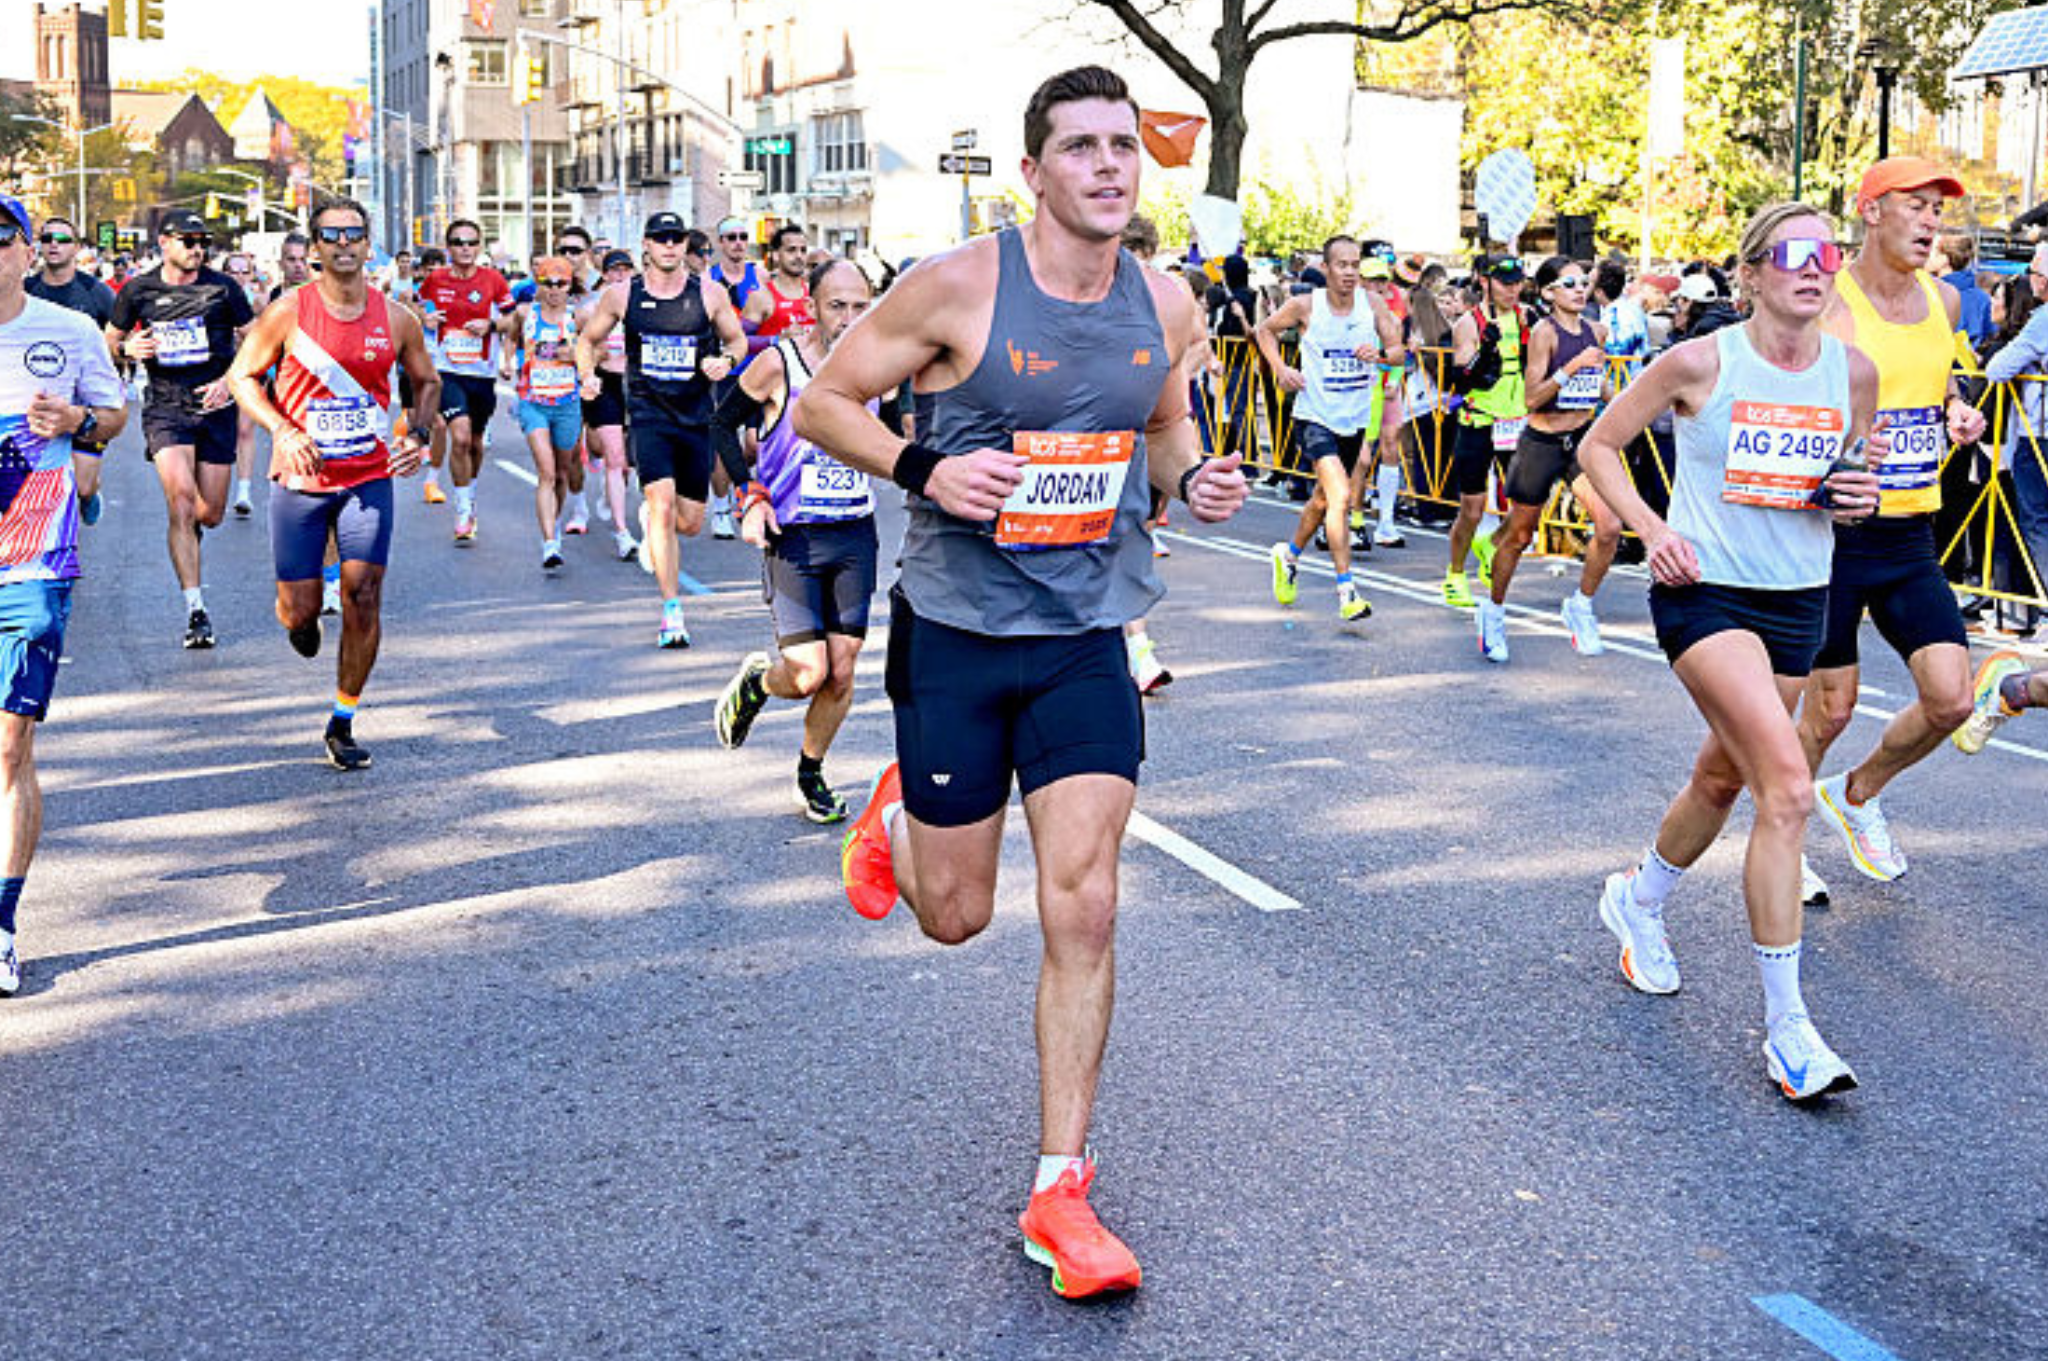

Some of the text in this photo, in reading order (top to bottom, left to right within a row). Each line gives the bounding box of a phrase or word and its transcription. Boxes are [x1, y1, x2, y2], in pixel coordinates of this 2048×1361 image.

[317, 411, 368, 431] 6858
[1029, 434, 1057, 456] tcs
[1733, 429, 1838, 460] AG 2492
[1026, 471, 1110, 505] JORDAN
